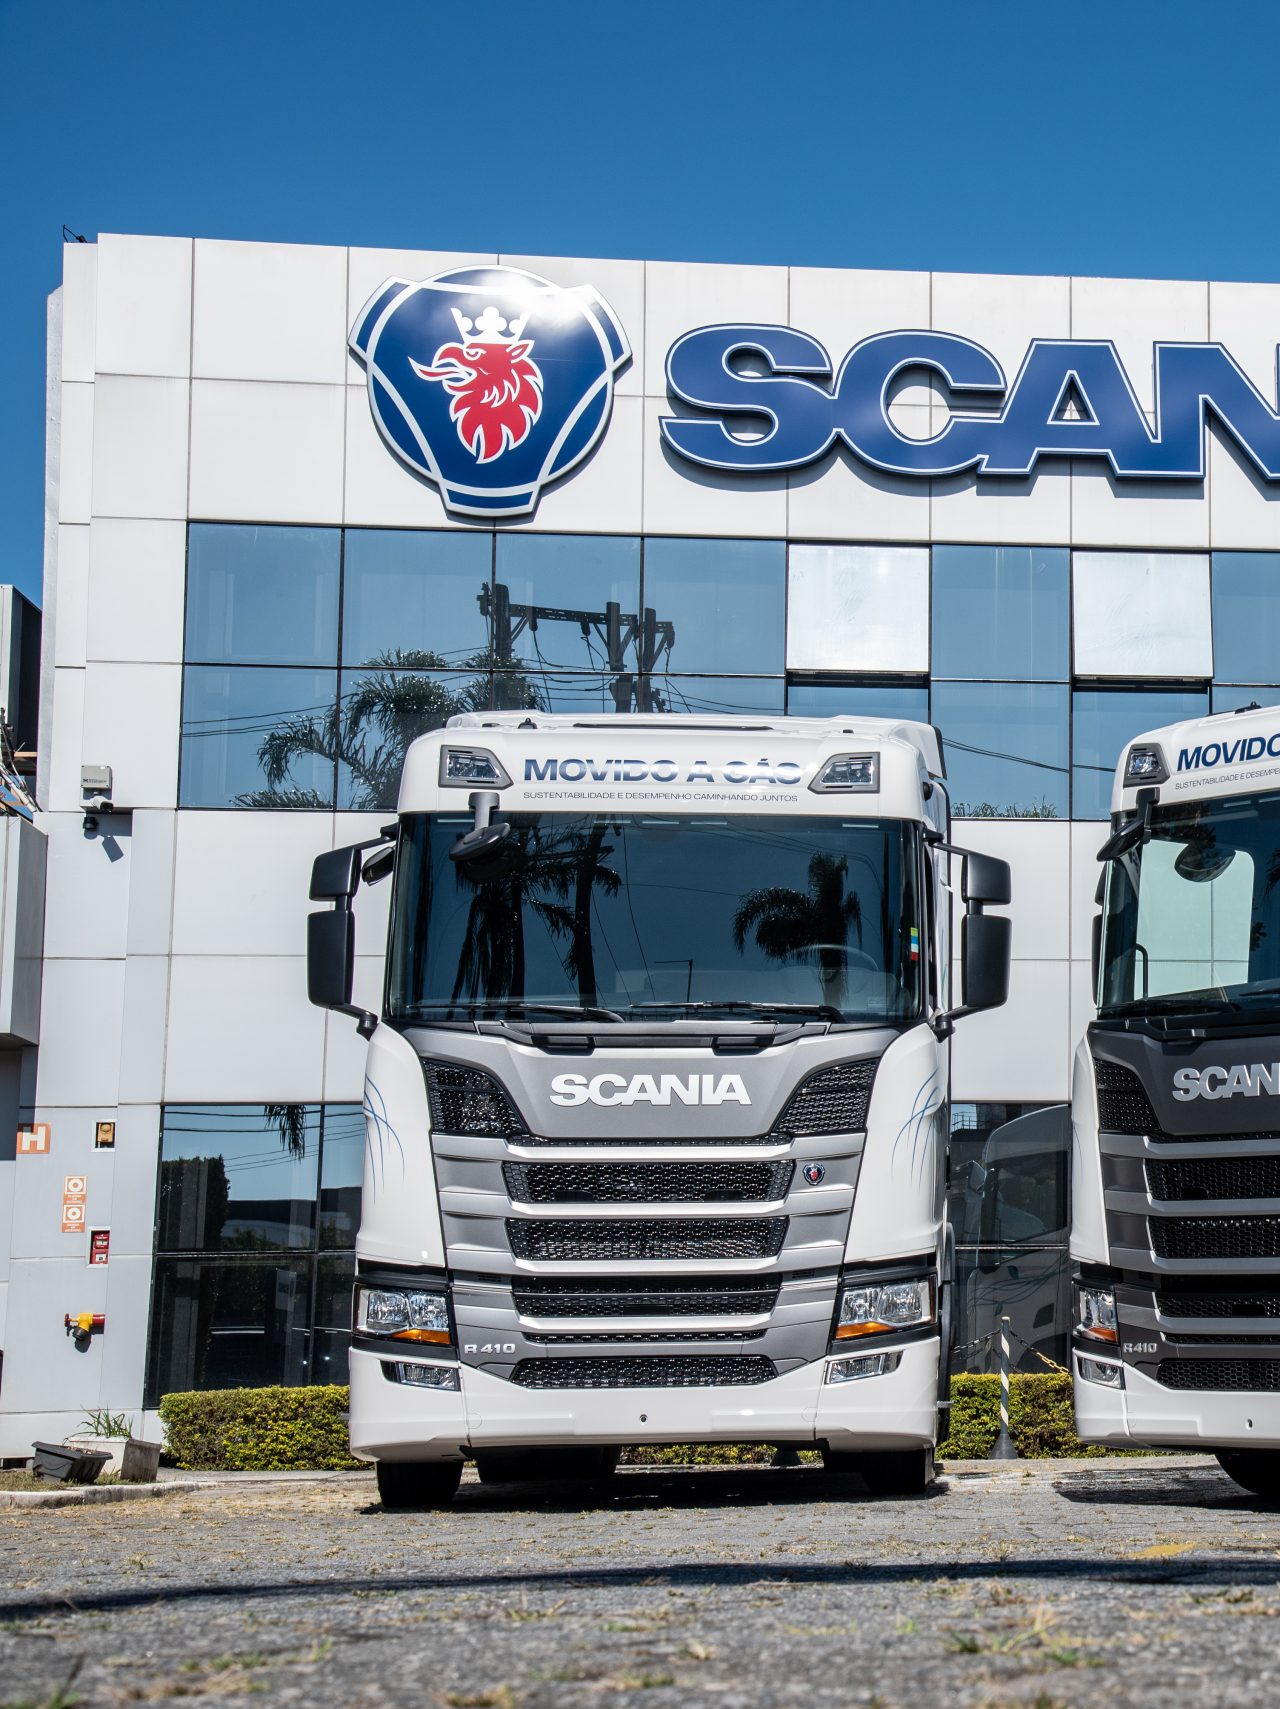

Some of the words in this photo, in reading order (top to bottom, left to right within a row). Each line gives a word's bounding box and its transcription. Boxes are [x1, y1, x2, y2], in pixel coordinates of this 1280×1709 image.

[523, 758, 680, 783] MOVIDO
[686, 760, 715, 783] A
[1174, 773, 1239, 790] SUSTENTABILIDADE
[1239, 772, 1245, 780] E
[523, 791, 616, 800] SUSTENTABILIDADE
[617, 792, 624, 800] E
[625, 792, 692, 801] DESEMPENHO
[693, 793, 759, 802] CAMINHANDO
[759, 794, 799, 802] JUNTOS
[549, 1073, 753, 1107] SCANIA
[21, 1126, 46, 1151] H
